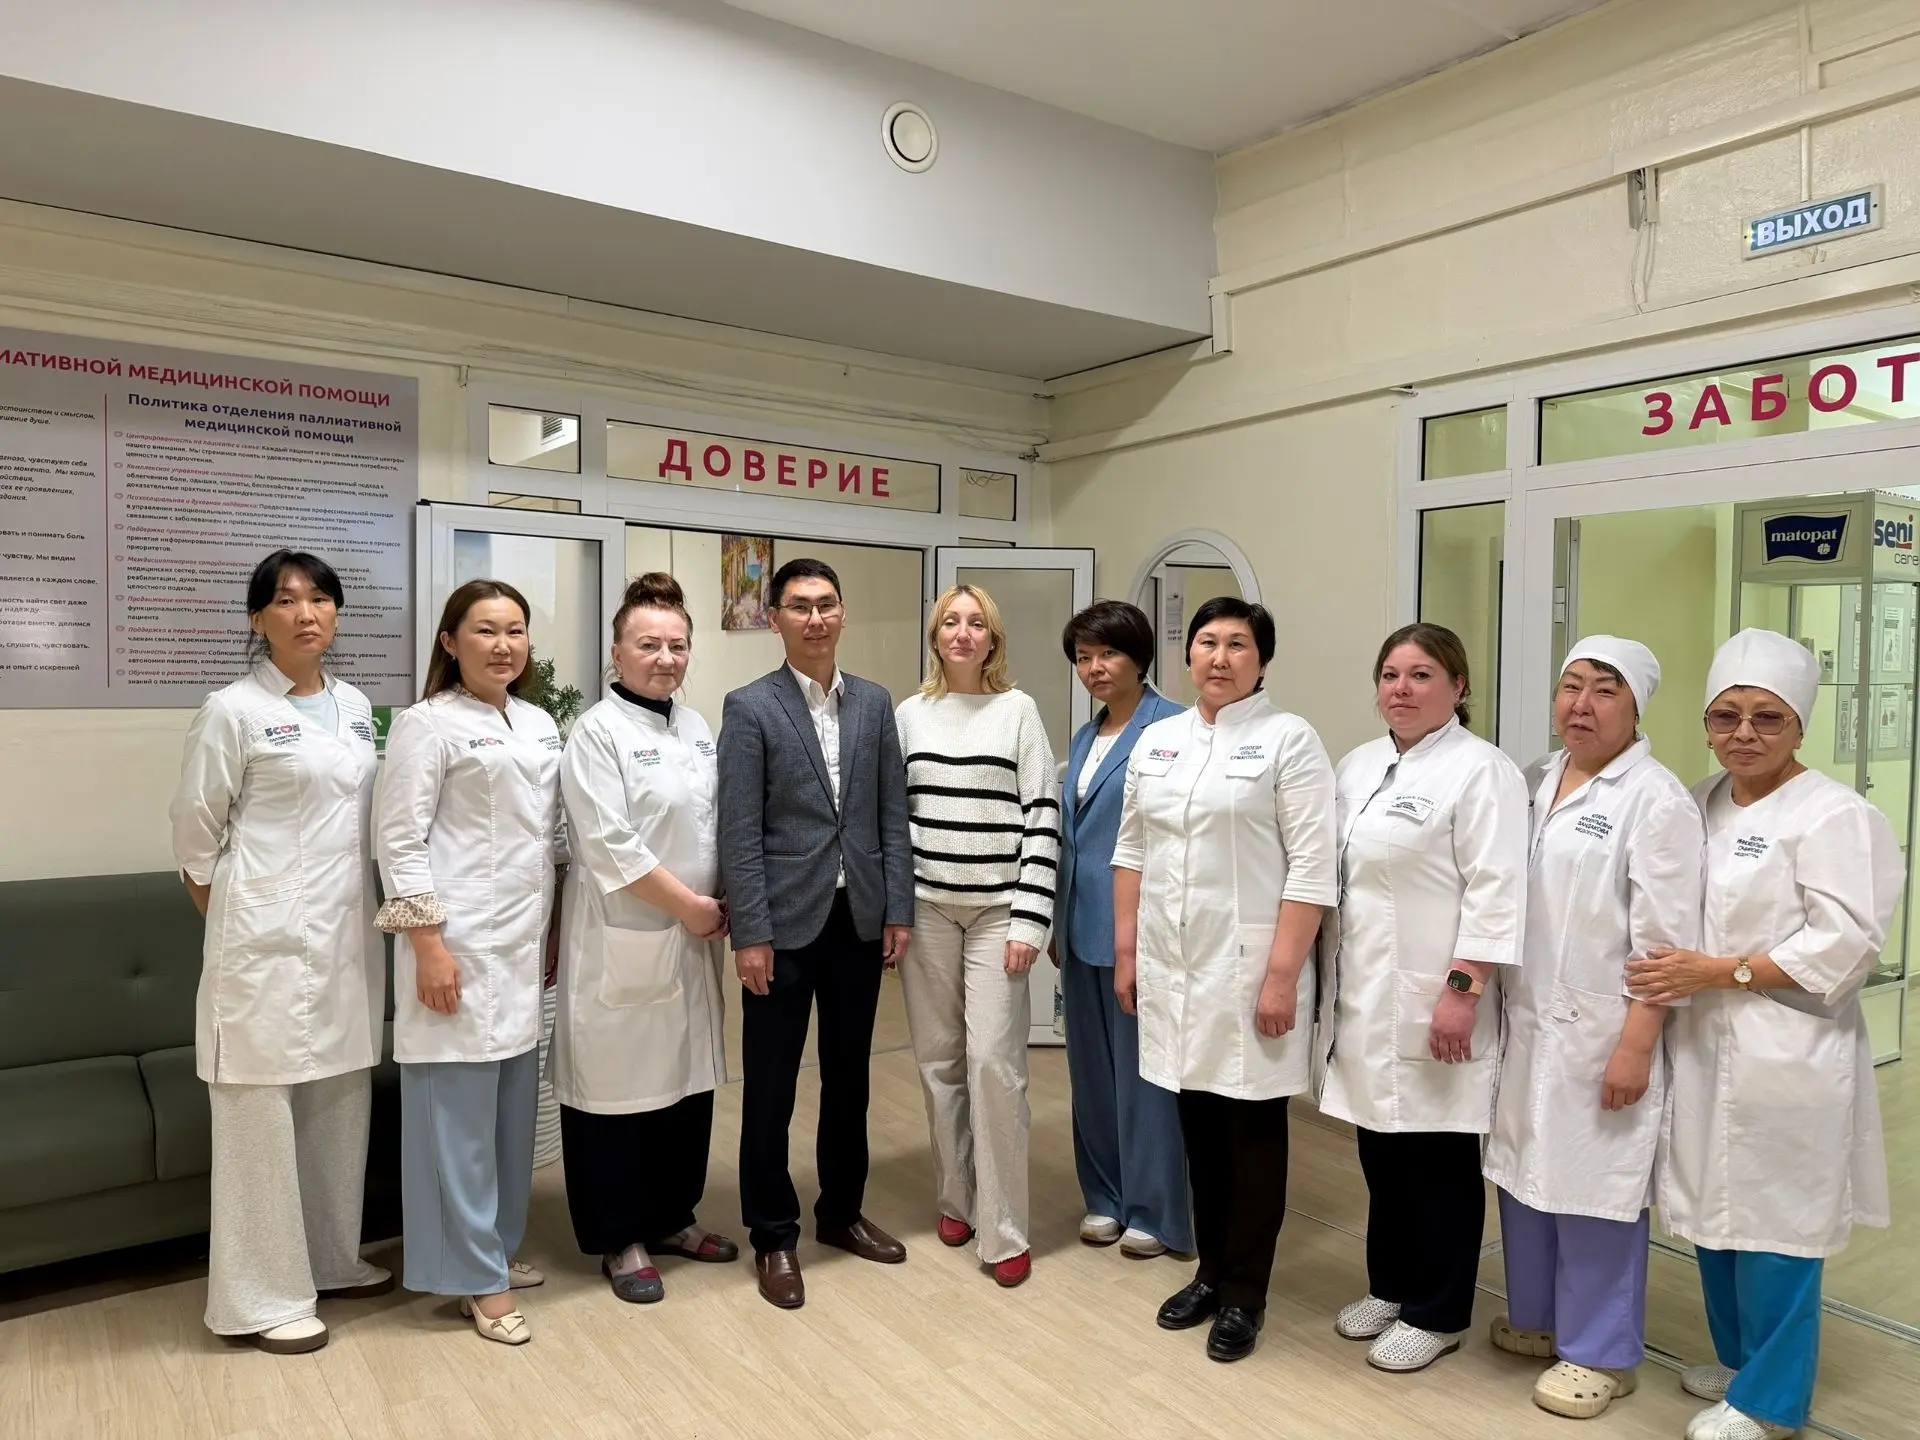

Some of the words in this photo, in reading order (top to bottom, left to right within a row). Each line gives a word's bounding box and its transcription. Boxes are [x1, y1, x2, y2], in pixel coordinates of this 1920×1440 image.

[1757, 197, 1867, 247] ВЫХОД
[0, 350, 121, 375] ИАТИВНОЙ
[128, 365, 292, 394] МЕДИЦИНСКОЙ
[298, 384, 389, 407] ПОМОЩИ
[1641, 352, 1920, 436] ЗАБОТ
[128, 393, 208, 412] Политика
[212, 404, 295, 420] отделения
[299, 414, 401, 431] паллиативной
[185, 419, 289, 436] медицинской
[294, 430, 353, 444] помощи
[659, 438, 890, 497] ДОВЕРИЕ
[1771, 529, 1837, 543] matopat
[1874, 514, 1913, 548] seni
[1894, 553, 1919, 566] care
